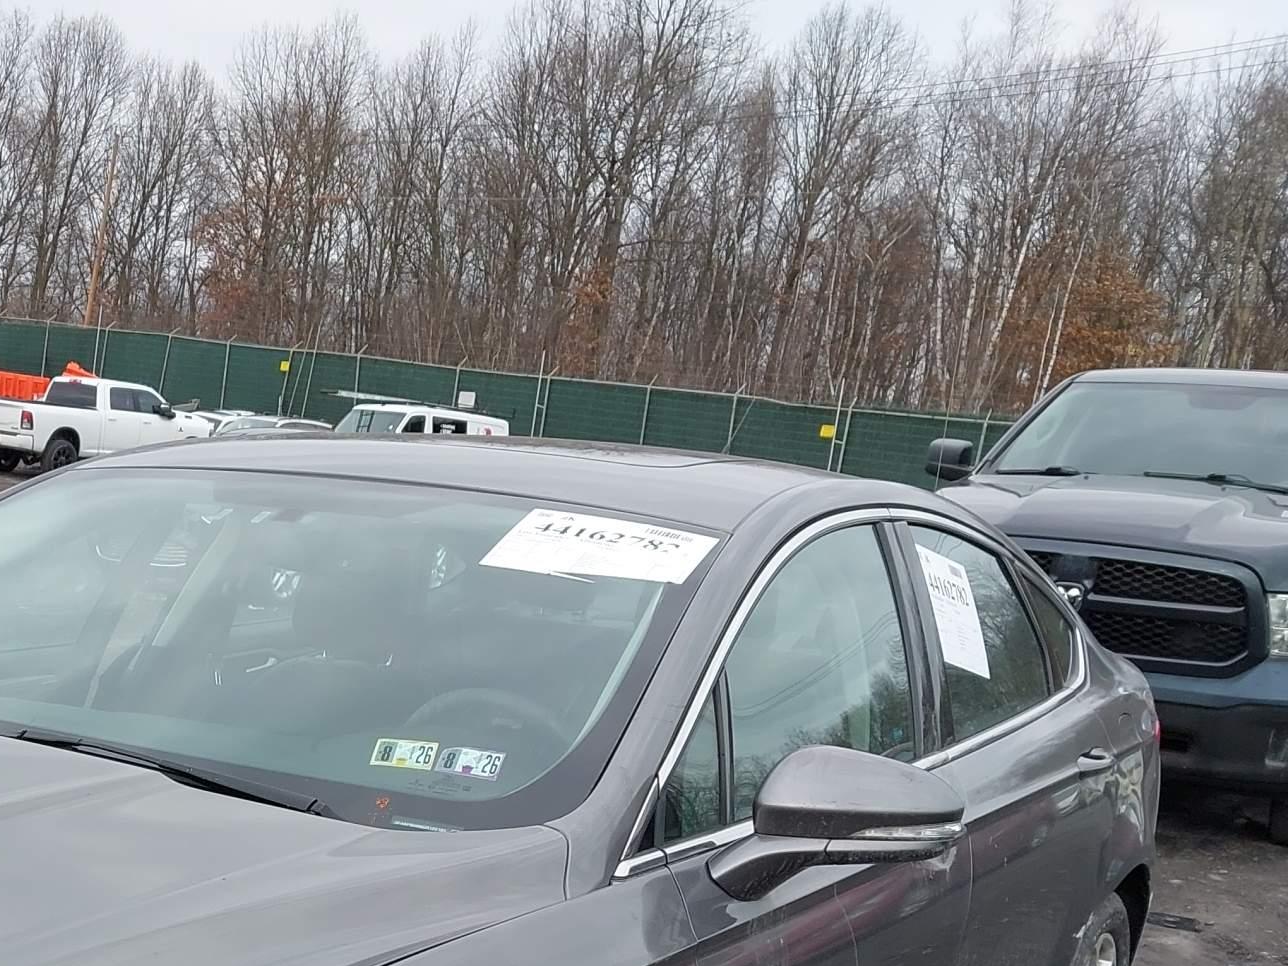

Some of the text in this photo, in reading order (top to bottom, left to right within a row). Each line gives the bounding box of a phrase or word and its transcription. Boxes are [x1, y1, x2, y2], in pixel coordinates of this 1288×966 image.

[534, 522, 681, 553] 44162782
[927, 573, 970, 607] 44162782
[415, 745, 434, 765] 26
[481, 754, 501, 775] 26
